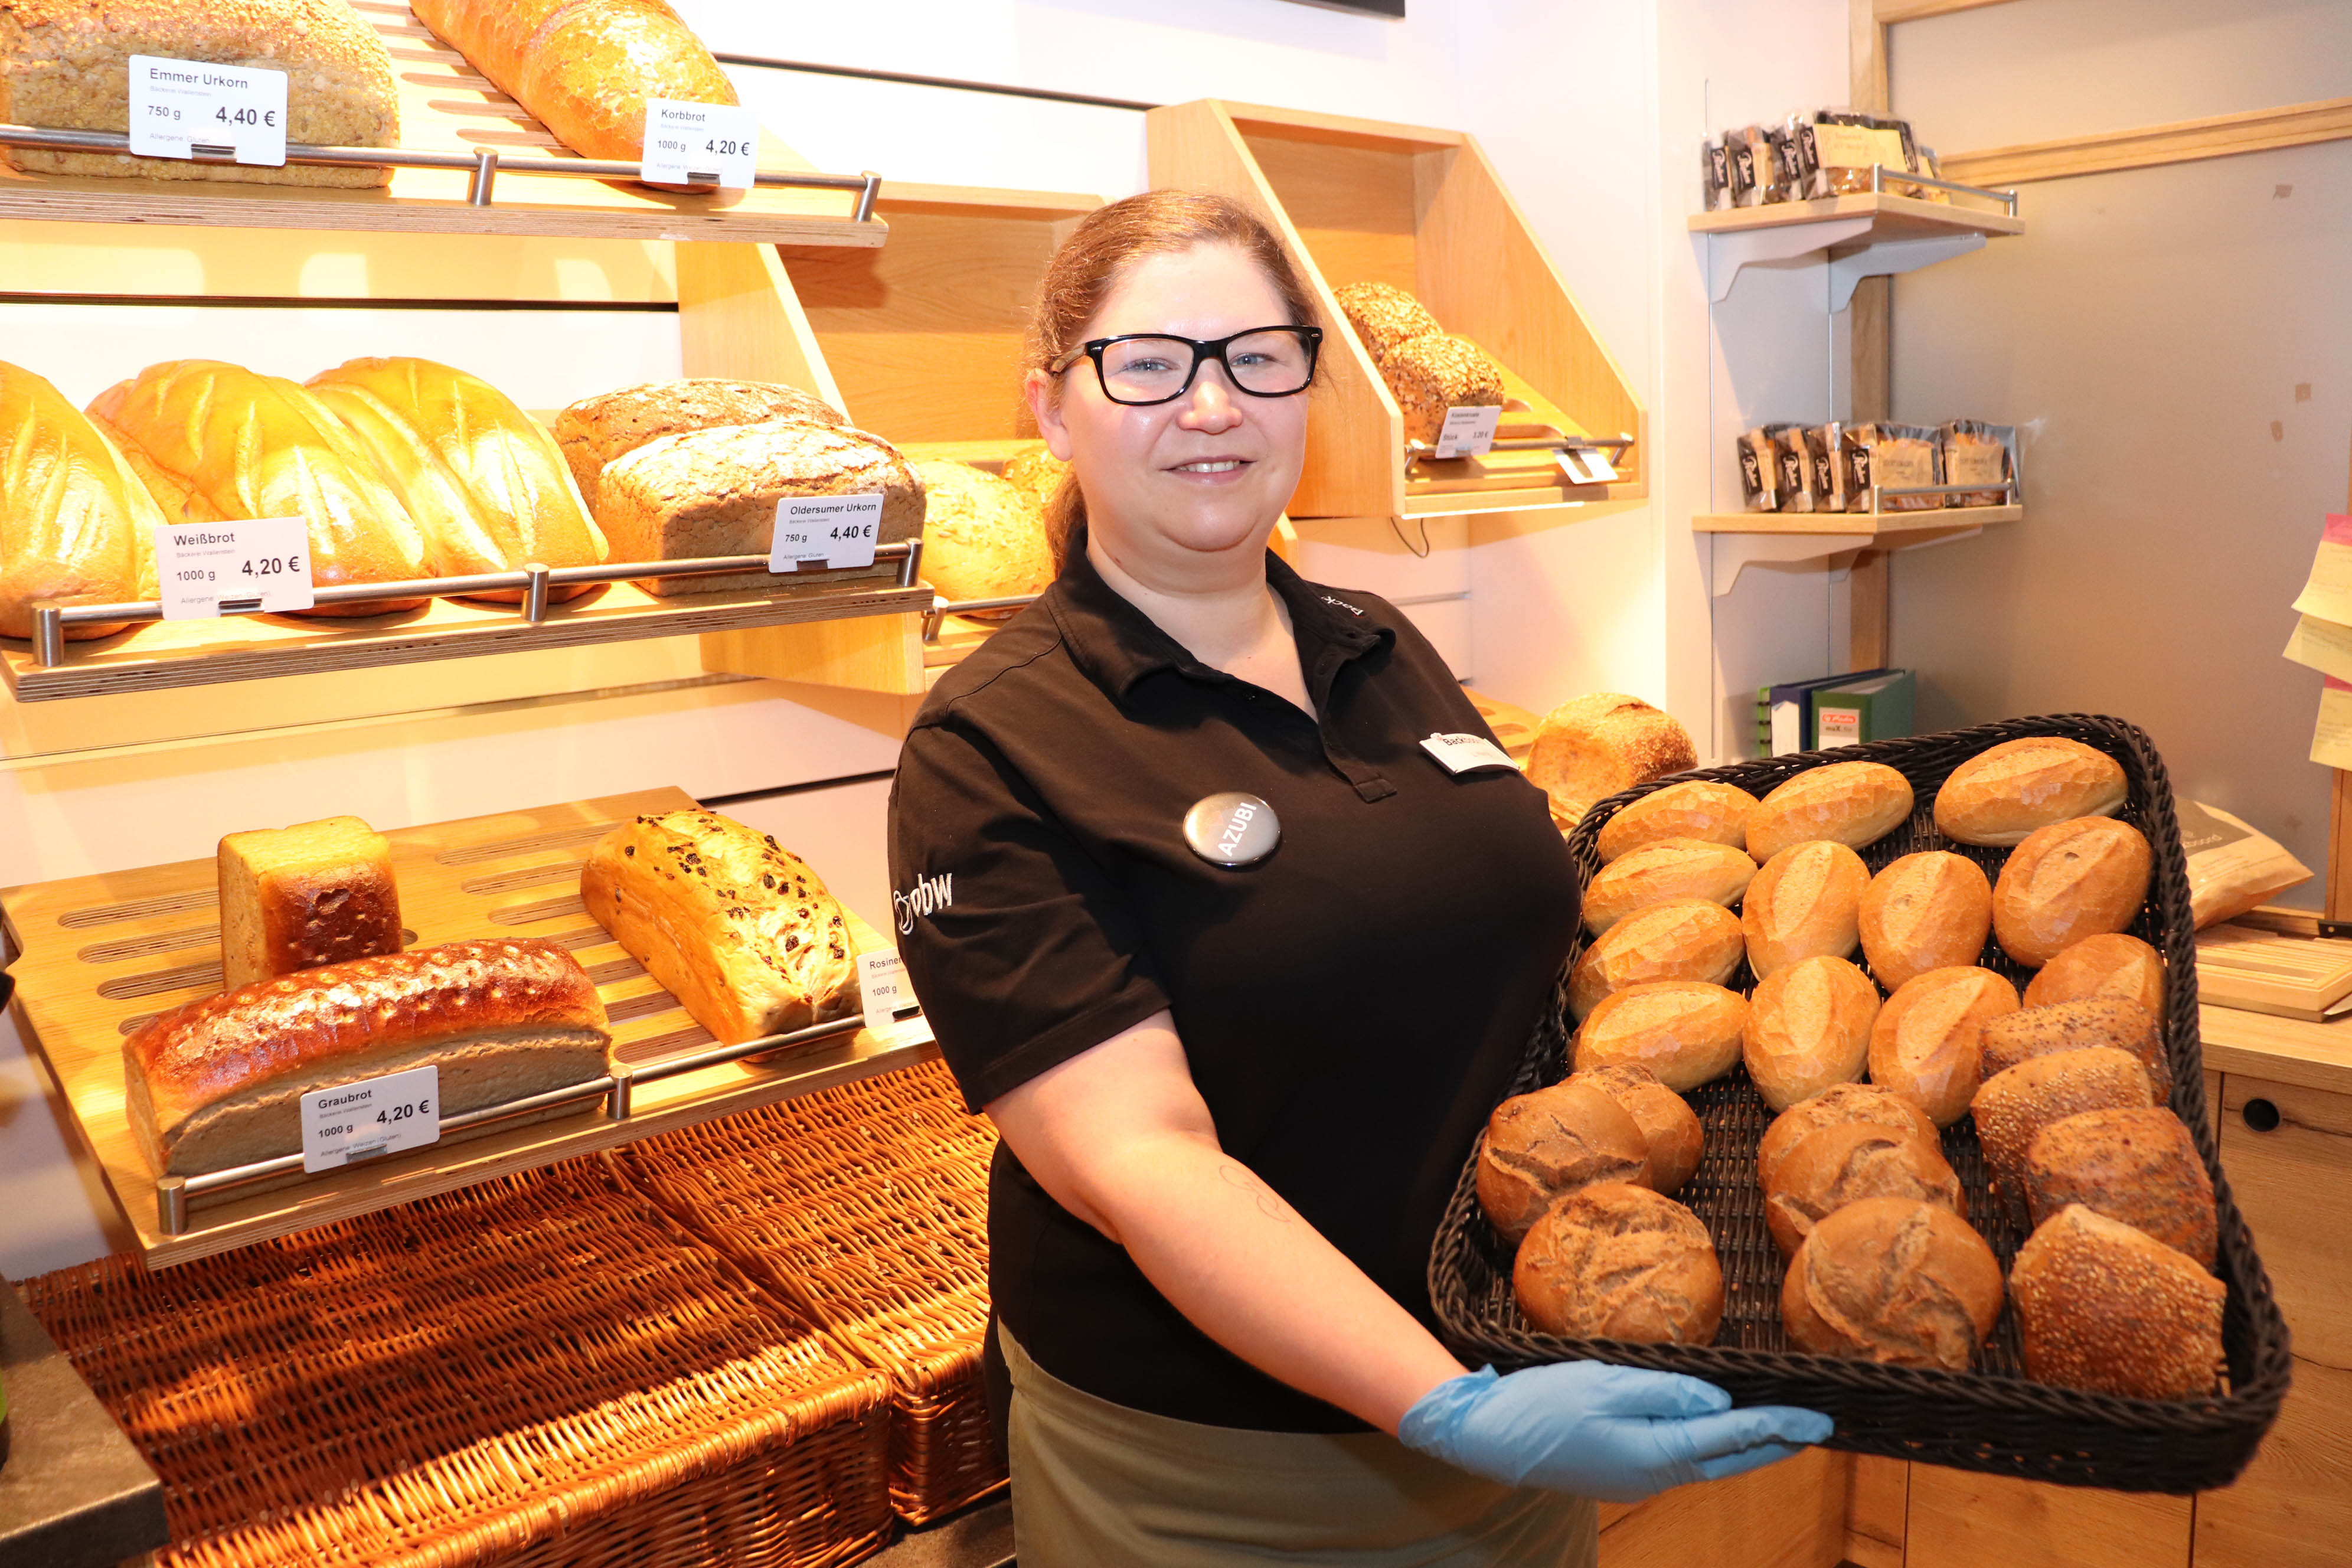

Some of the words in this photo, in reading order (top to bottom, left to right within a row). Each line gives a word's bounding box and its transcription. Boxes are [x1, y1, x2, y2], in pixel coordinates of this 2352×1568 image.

[150, 68, 198, 83] Emmer
[203, 74, 248, 89] Urkorn
[148, 104, 169, 117] 750
[174, 110, 181, 120] g
[215, 106, 257, 126] 4,40
[264, 110, 276, 127] €
[661, 109, 705, 122] Korbbrot
[657, 140, 678, 149] 1000
[680, 143, 686, 152] g
[705, 139, 736, 155] 4,20
[741, 142, 750, 156] €
[790, 505, 844, 515] Oldersumer
[847, 503, 876, 512] Urkorn
[174, 533, 236, 546] Weißbrot
[785, 534, 800, 542] 750
[802, 534, 808, 543] g
[830, 525, 859, 541] 4,40
[863, 524, 872, 537] €
[241, 557, 282, 579] 4,20
[288, 556, 300, 572] €
[177, 570, 204, 582] 1000
[208, 571, 215, 582] g
[1218, 802, 1257, 857] AZUBI
[873, 986, 890, 997] 1000
[318, 1089, 373, 1109] Graubrot
[377, 1103, 413, 1125] 4,20
[419, 1099, 430, 1114] €
[318, 1125, 343, 1138] 1000
[347, 1124, 354, 1133] g
